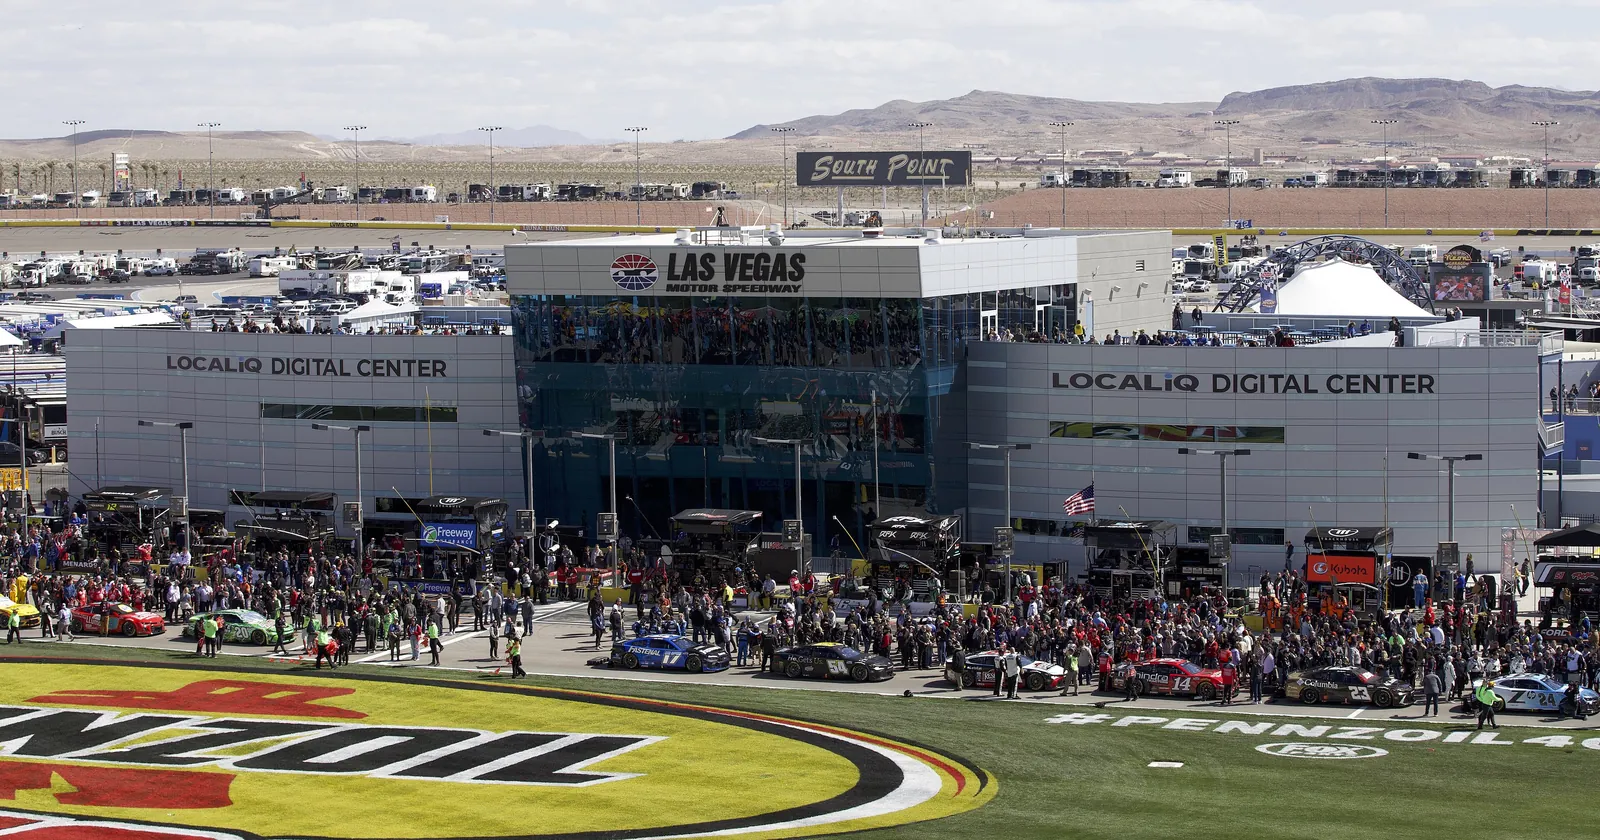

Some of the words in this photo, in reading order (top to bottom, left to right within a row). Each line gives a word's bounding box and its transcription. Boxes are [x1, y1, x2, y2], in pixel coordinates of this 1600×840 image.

[811, 155, 878, 182] SOUTH
[887, 153, 954, 183] POINT
[667, 252, 716, 281] LAS
[723, 252, 806, 282] VEGAS
[666, 283, 719, 292] MOTOR
[722, 284, 802, 293] SPEEDWAY
[271, 357, 351, 376] DIGITAL
[357, 359, 447, 377] CENTER
[1212, 373, 1318, 393] DIGITAL
[1326, 373, 1435, 394] CENTER
[437, 526, 474, 540] Freeway
[1330, 563, 1369, 575] Kubota
[235, 626, 249, 639] 20
[628, 645, 661, 657] FASTENAL
[662, 654, 680, 664] 17
[826, 660, 850, 675] 54
[1172, 676, 1191, 691] 14
[1304, 679, 1339, 690] Columbia
[1348, 685, 1371, 700] 23
[1538, 693, 1557, 706] 24
[1044, 712, 1514, 746] #PENNZOIL
